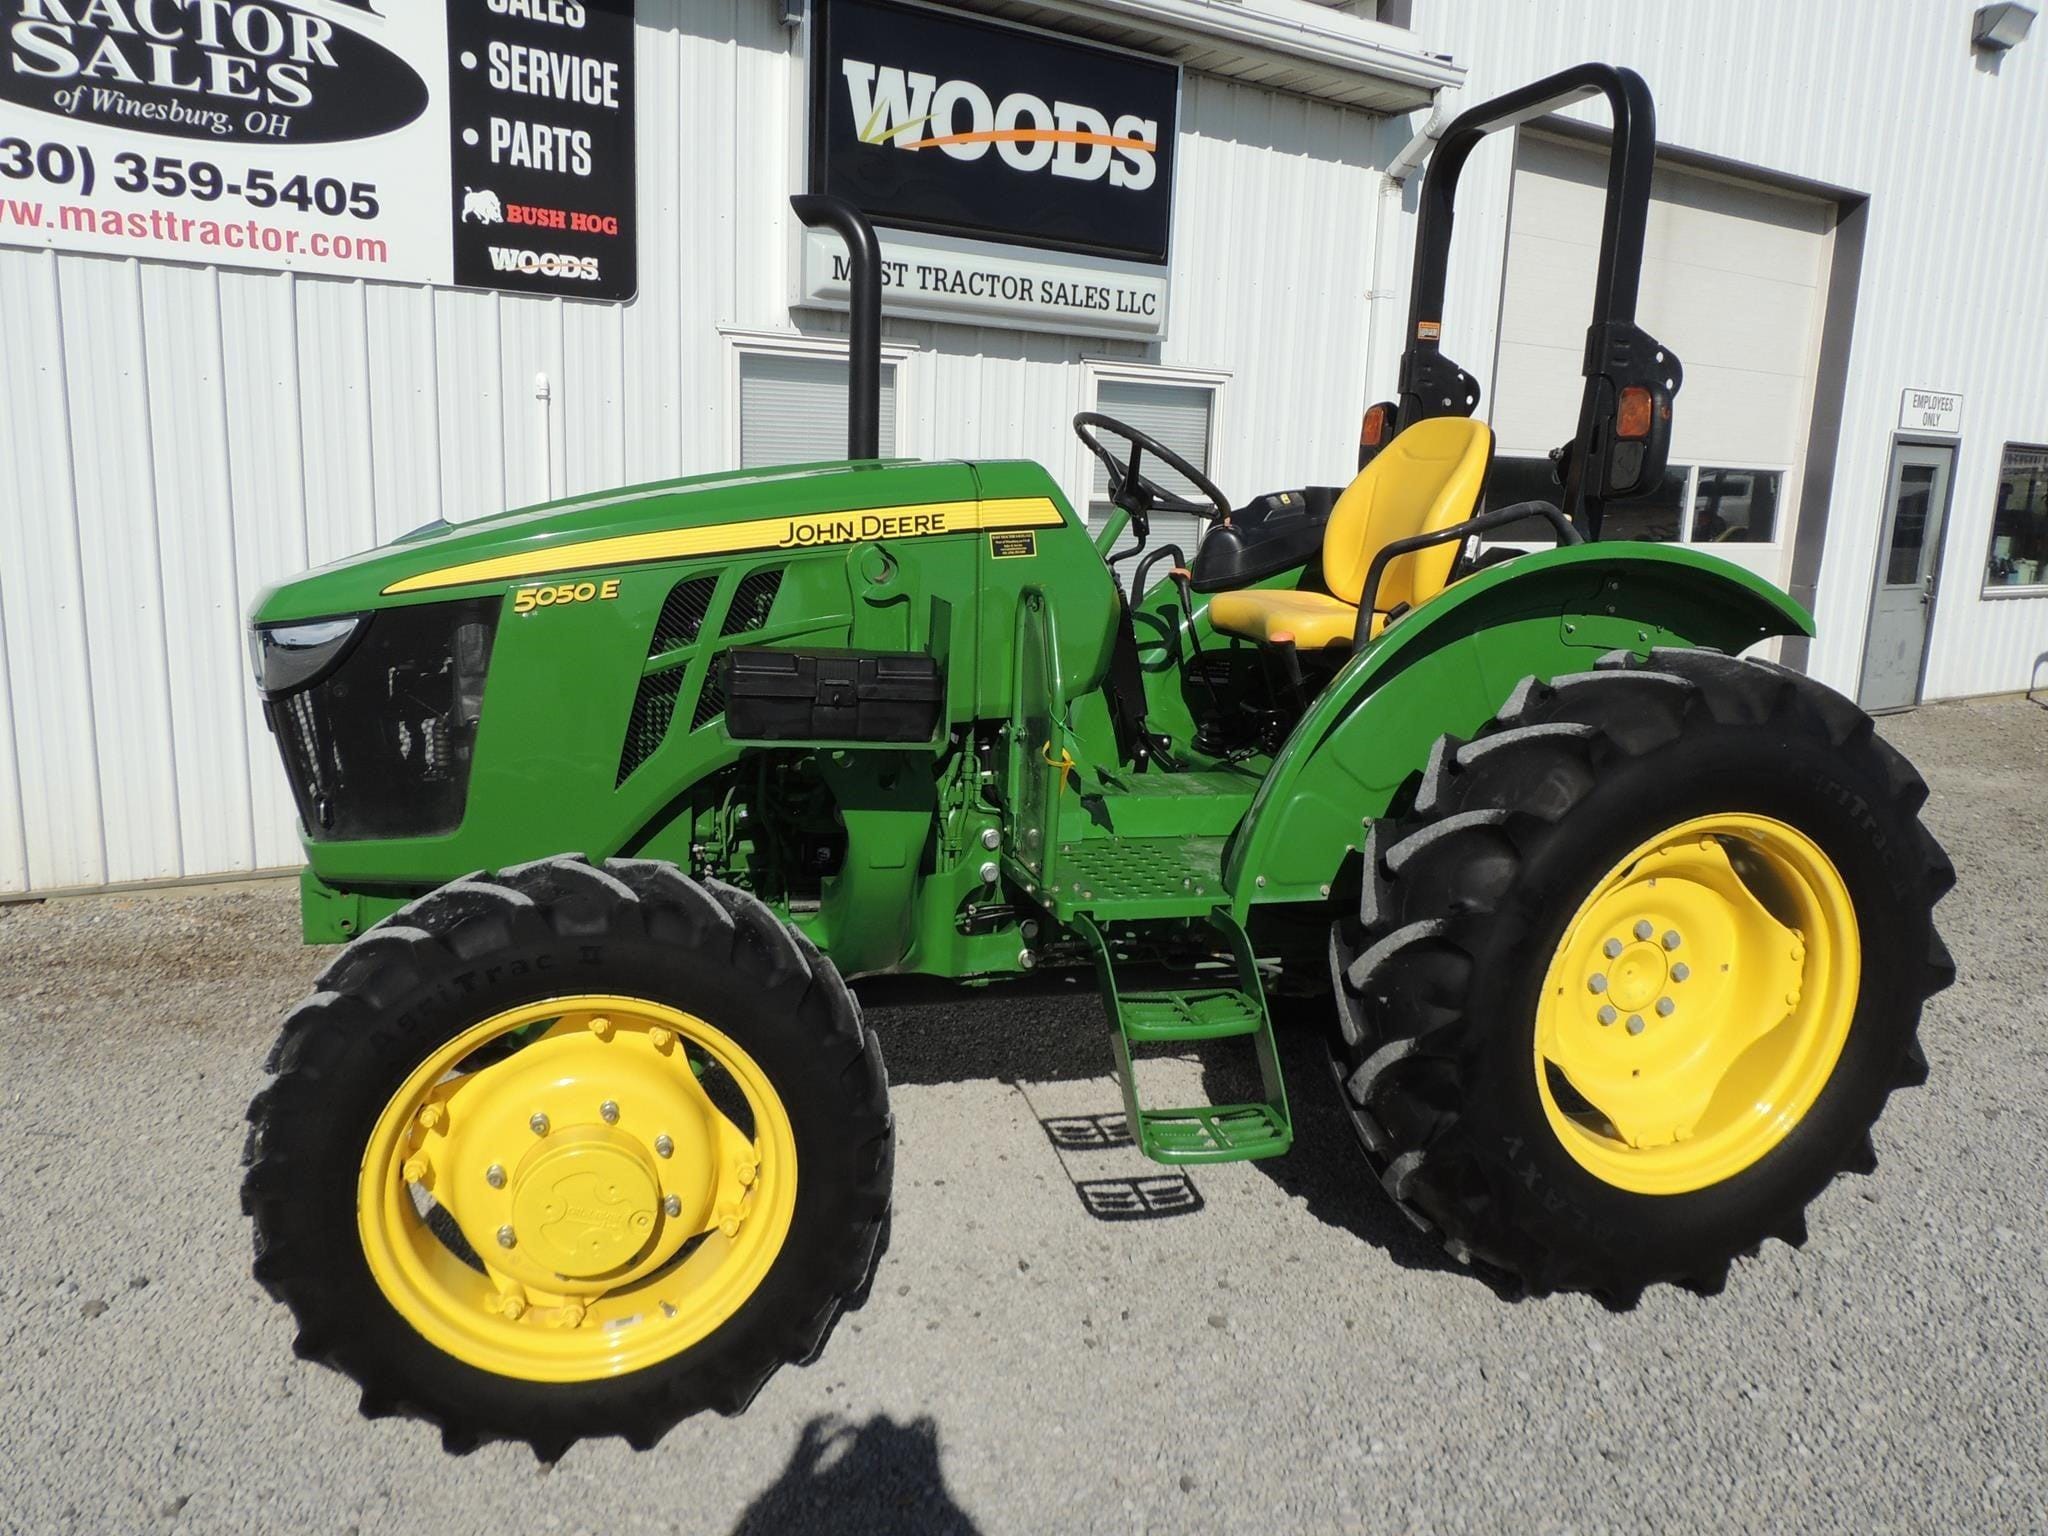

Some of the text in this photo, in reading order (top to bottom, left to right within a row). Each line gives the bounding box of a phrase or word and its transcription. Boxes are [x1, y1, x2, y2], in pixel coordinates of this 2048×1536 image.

[486, 0, 586, 29] LES
[11, 20, 313, 107] SALES
[487, 40, 619, 108] SERVICE
[53, 85, 292, 137] of Winesburg, OH
[842, 58, 1158, 191] WOODS
[490, 116, 592, 176] PARTS
[113, 151, 381, 220] 359-5405
[0, 199, 388, 263] w.masttractor.com
[506, 203, 618, 236] BUSH HOG
[488, 246, 599, 280] WOODS
[831, 255, 1157, 316] MST TRACTOR SALES LLC
[1912, 394, 1954, 412] EMPLOYEES
[1922, 412, 1941, 427] ONLY
[779, 513, 946, 545] JOHN DEERE
